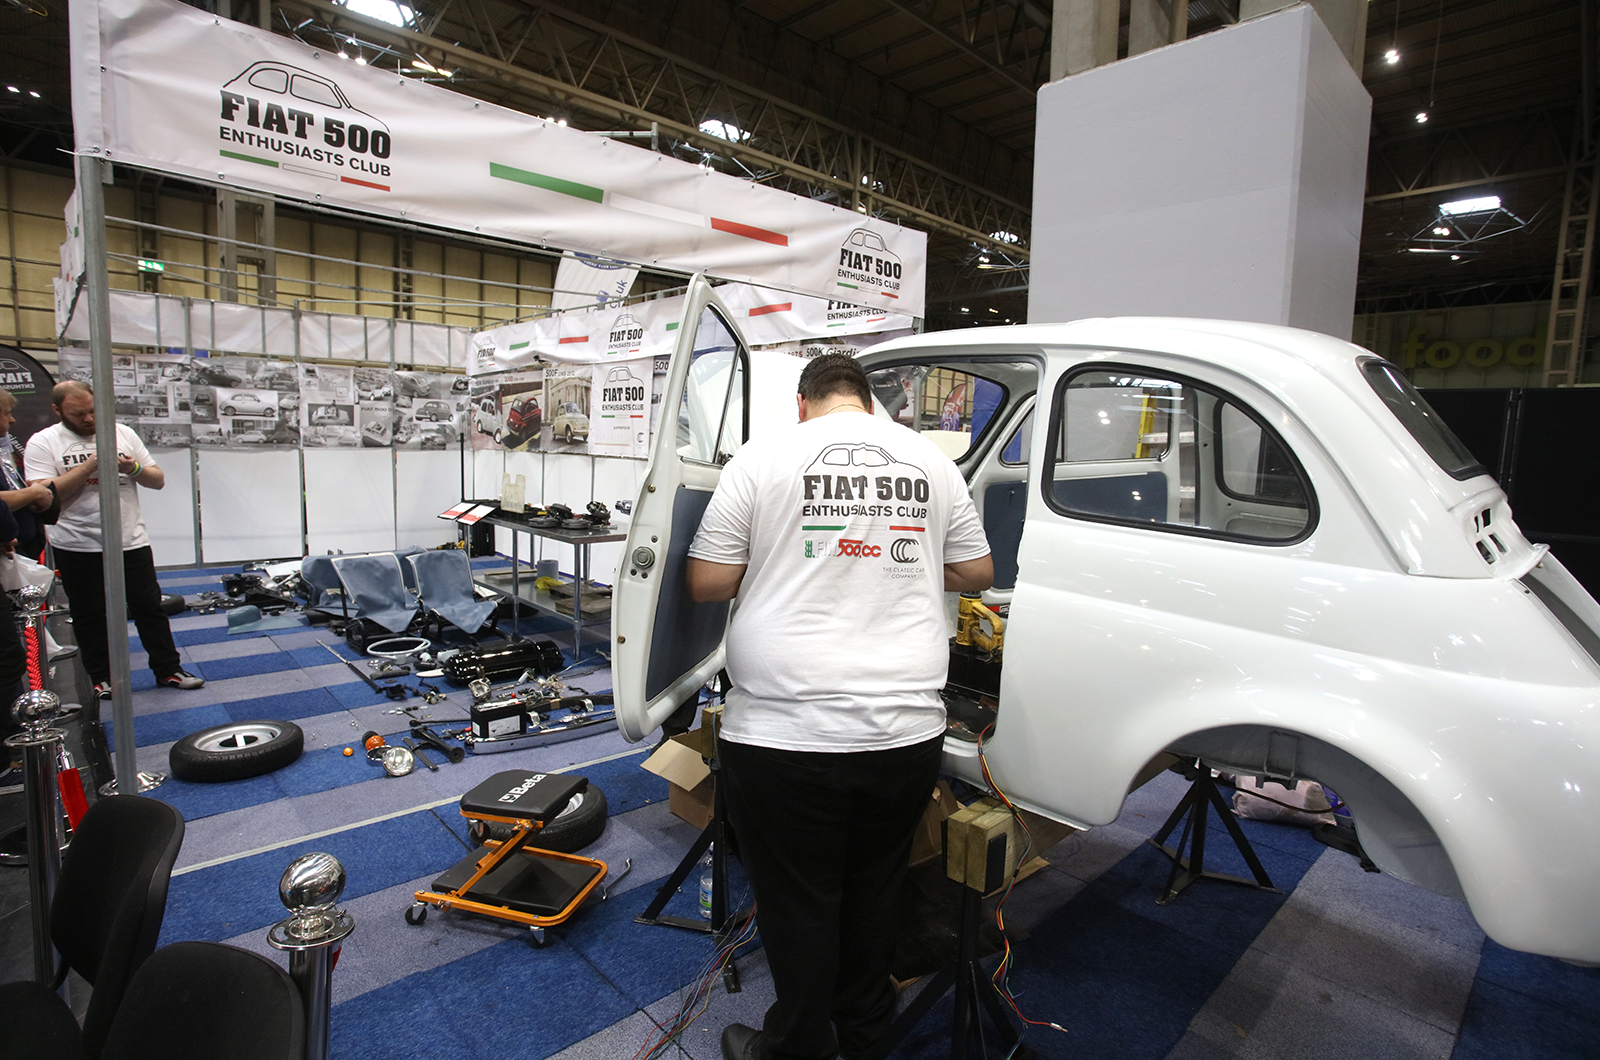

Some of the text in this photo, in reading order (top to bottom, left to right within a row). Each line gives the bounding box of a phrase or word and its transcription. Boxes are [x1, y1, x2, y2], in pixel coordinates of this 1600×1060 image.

[221, 90, 391, 159] FIAT 500
[220, 126, 391, 177] ENTHUSIASTS CLUB
[840, 248, 902, 280] FIAT 500
[837, 269, 900, 290] ENTHUSIASTS CLUB
[827, 310, 871, 320] ENTHUSIASTS
[609, 327, 643, 343] FIAT 500
[806, 347, 824, 357] 500K
[1401, 325, 1547, 369] food
[602, 385, 645, 402] FIAT 500
[601, 402, 644, 412] ENTHUSIASTS CLUB
[62, 453, 92, 465] FIA
[803, 475, 930, 503] FIAT 500
[802, 504, 927, 519] ENTHUSIASTS CLUB
[508, 774, 547, 795] Beta
